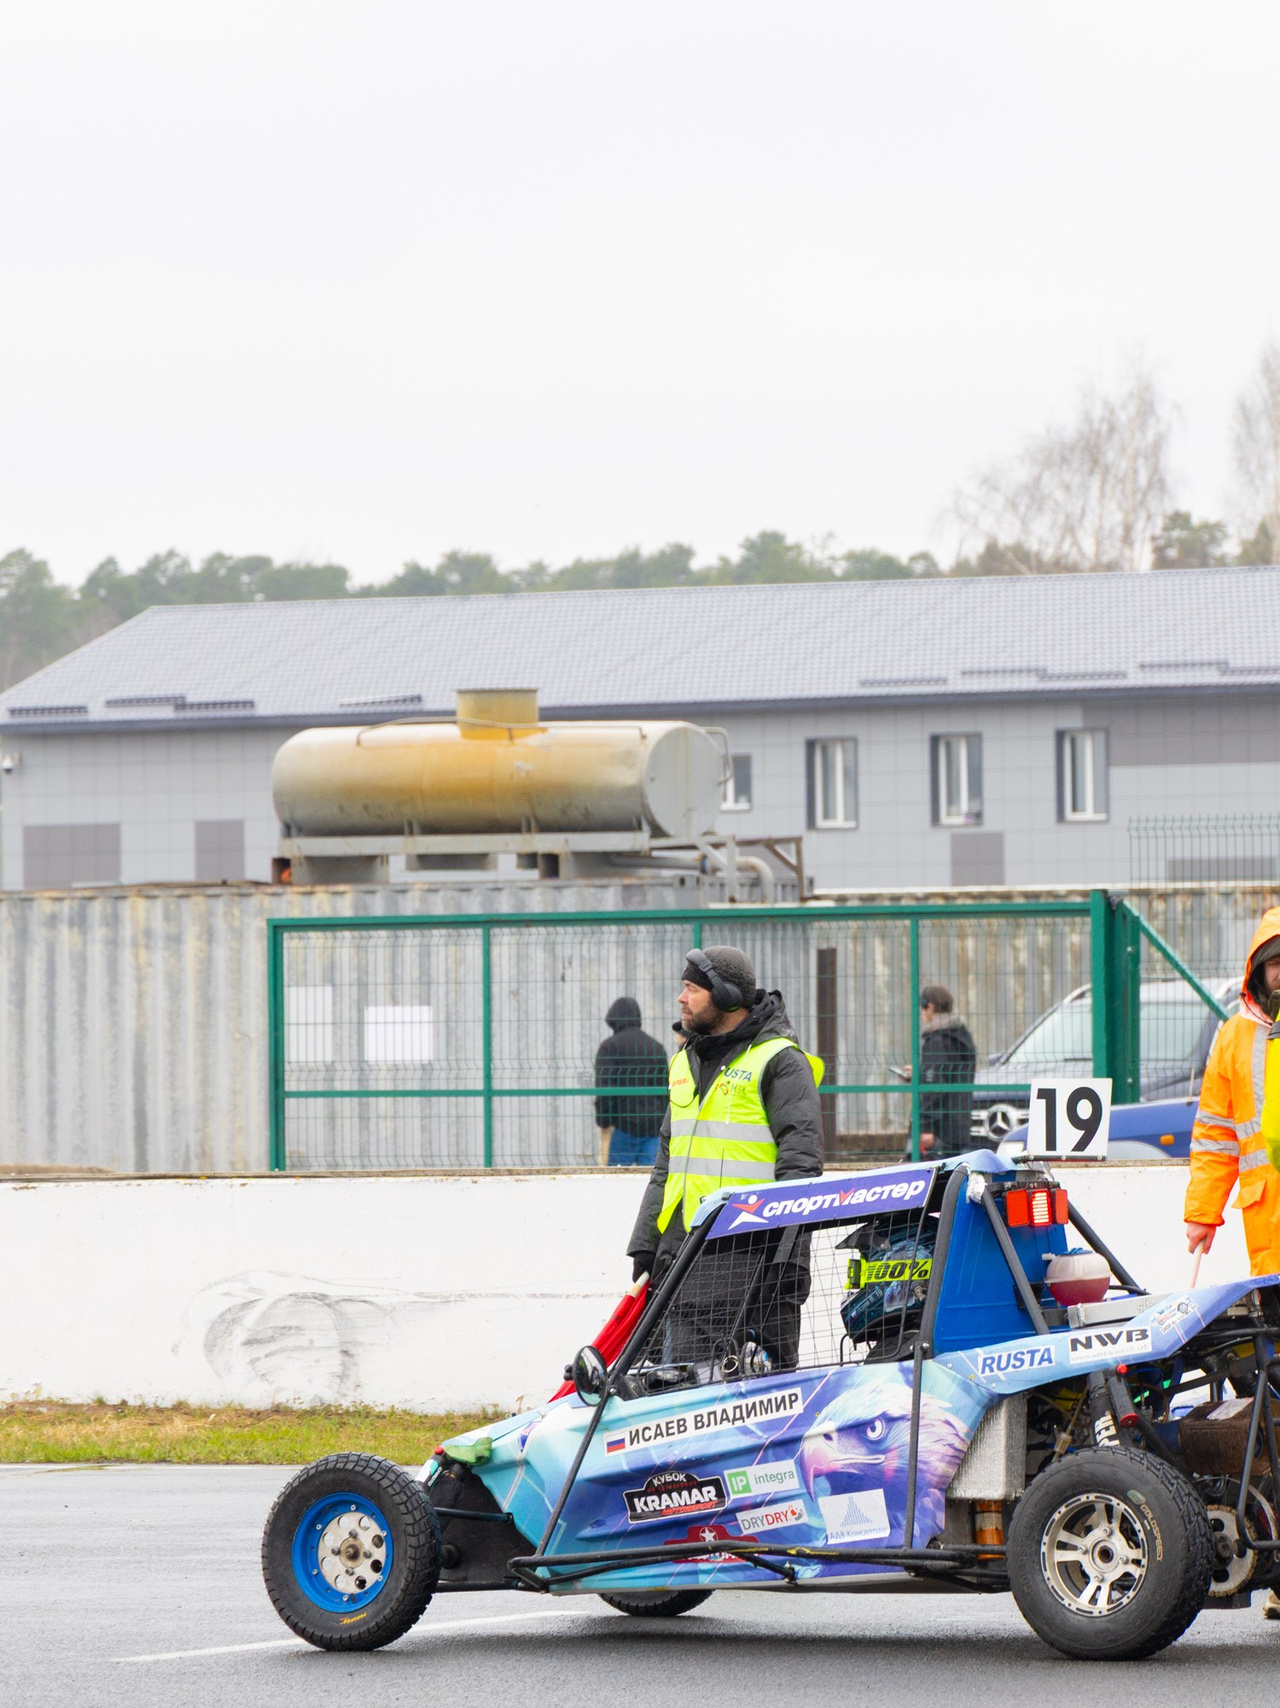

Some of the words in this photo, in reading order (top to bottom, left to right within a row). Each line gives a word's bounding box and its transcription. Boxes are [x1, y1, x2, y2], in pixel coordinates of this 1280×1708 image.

[1036, 1086, 1103, 1152] 19
[866, 1260, 930, 1281] 100%
[1070, 1329, 1149, 1352] NWB
[981, 1347, 1054, 1374] RUSTA
[629, 1416, 688, 1447] ИСАЕВ
[694, 1392, 800, 1430] ВЛАДИМИР
[652, 1472, 687, 1487] КУБОК
[754, 1469, 795, 1485] integra
[633, 1485, 718, 1514] KRAMAR
